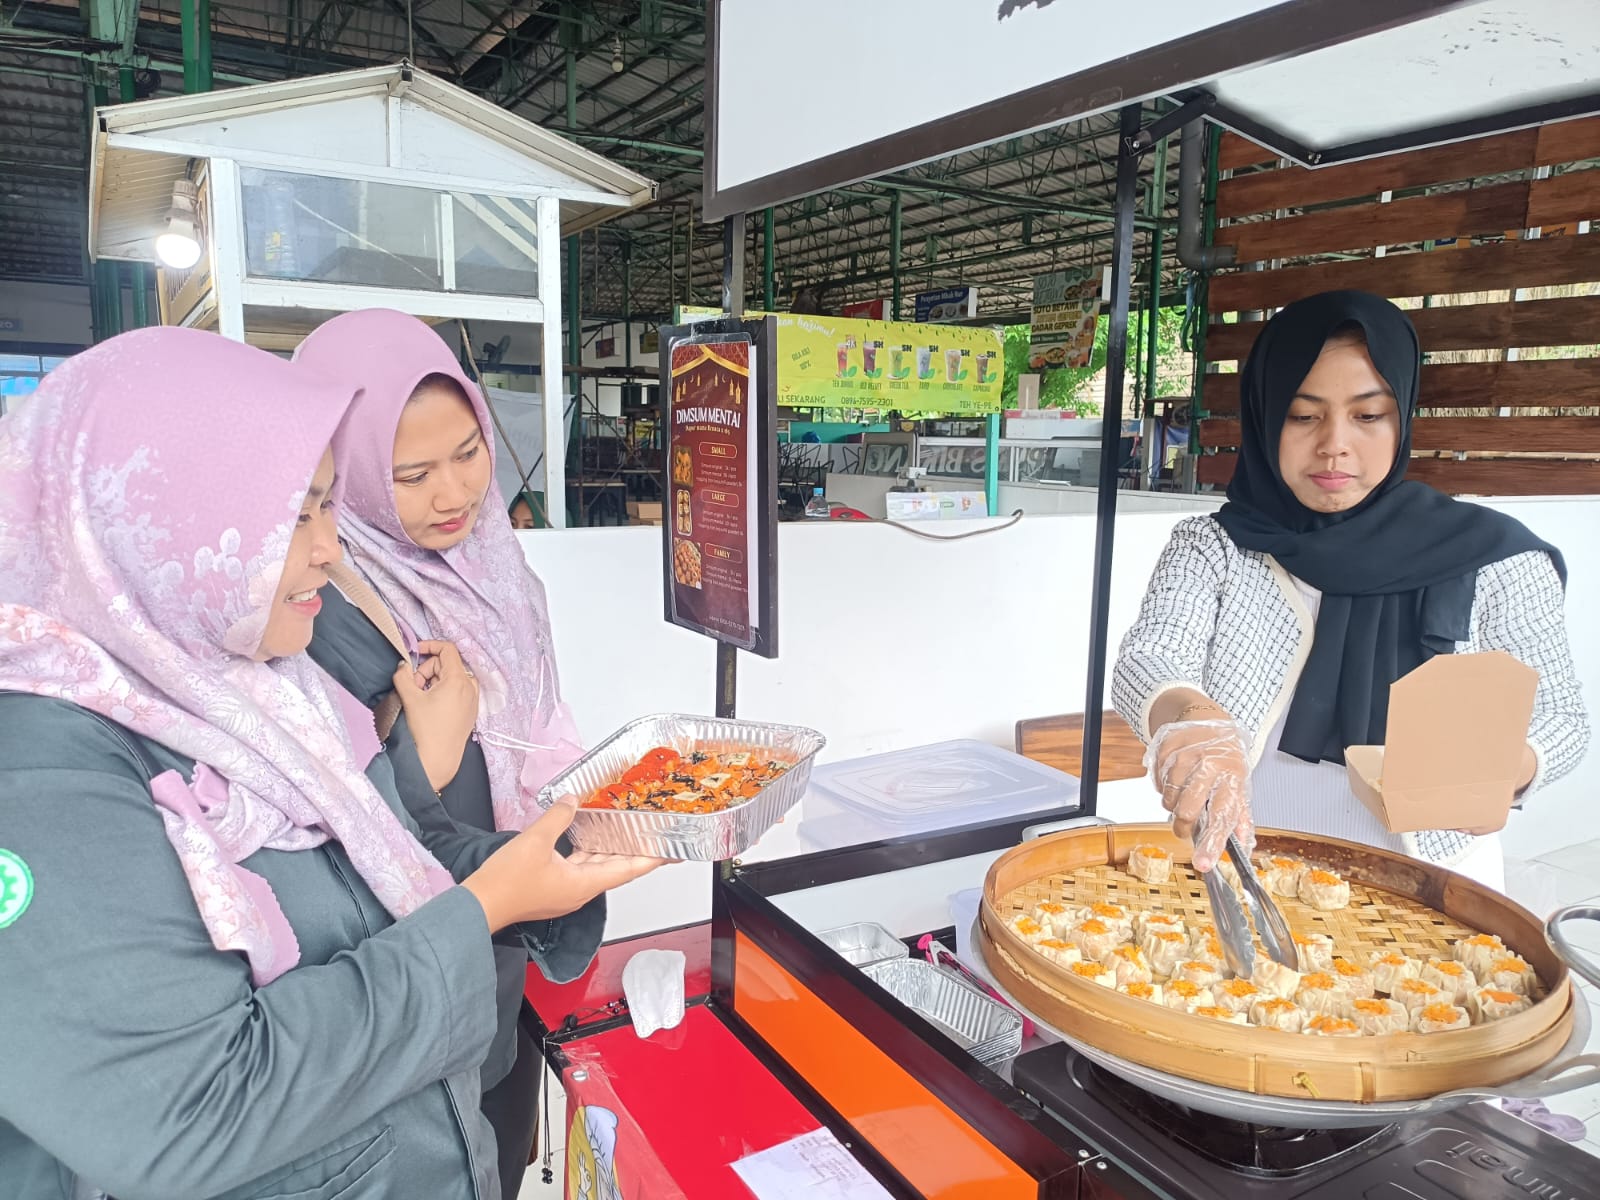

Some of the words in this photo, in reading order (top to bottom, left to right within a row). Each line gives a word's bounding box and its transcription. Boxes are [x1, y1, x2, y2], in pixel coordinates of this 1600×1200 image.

[785, 395, 826, 404] SEKARANG
[676, 407, 707, 425] DIMSUM
[707, 407, 741, 429] MENTAI
[711, 491, 726, 502] LARGE
[713, 548, 731, 559] FAMILY
